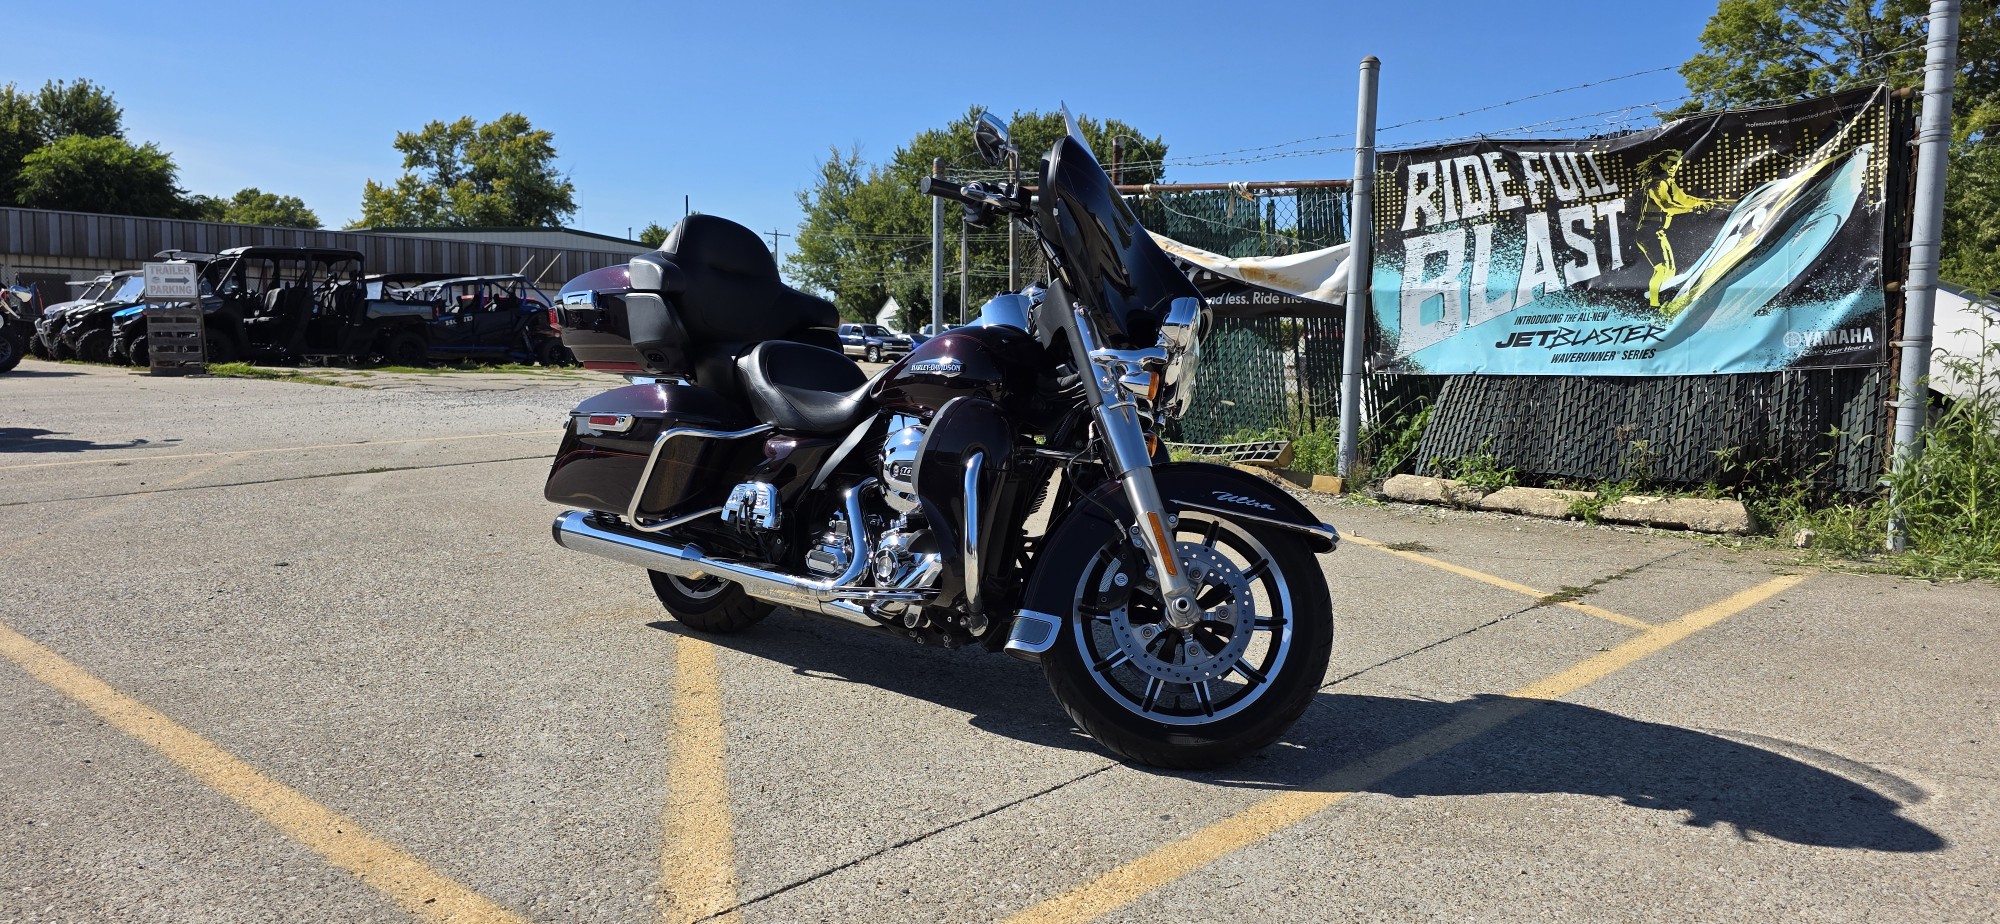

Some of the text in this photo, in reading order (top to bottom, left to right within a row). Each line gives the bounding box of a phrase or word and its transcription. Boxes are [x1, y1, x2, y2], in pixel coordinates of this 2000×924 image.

[1745, 119, 1777, 128] Professional
[1777, 117, 1790, 125] rider
[1791, 113, 1819, 123] depicted
[1833, 104, 1853, 114] closed
[1401, 151, 1619, 231] RIDE FULL
[149, 265, 191, 275] TRAILER
[1395, 198, 1626, 357] BLAST
[150, 285, 193, 294] PARKING
[1225, 292, 1250, 305] less.
[1252, 291, 1280, 305] Ride
[1514, 311, 1610, 326] INTRODUCING THE ALL-NEW
[1803, 327, 1874, 348] YAMAHA
[1621, 348, 1657, 361] SERIES
[1824, 346, 1843, 356] Your
[1843, 344, 1866, 353] Heart
[1212, 491, 1277, 511] Ultra
